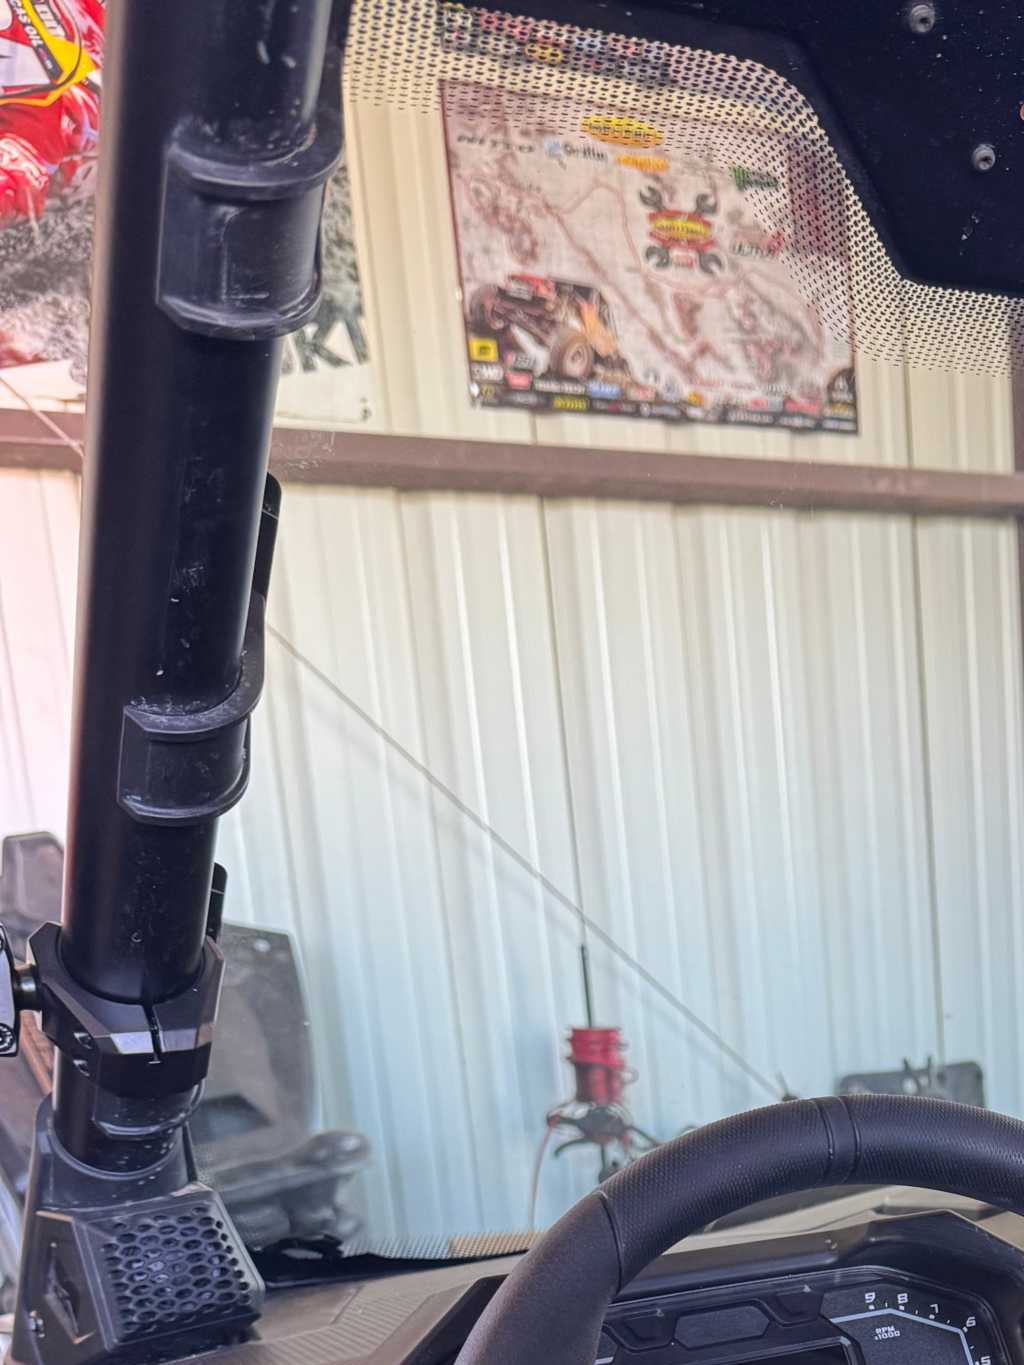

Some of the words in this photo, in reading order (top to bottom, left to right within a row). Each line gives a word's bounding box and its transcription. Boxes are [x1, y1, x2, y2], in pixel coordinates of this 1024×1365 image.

[865, 1292, 876, 1303] 9
[897, 1293, 908, 1304] 8
[930, 1304, 939, 1314] 7
[966, 1316, 976, 1327] 6
